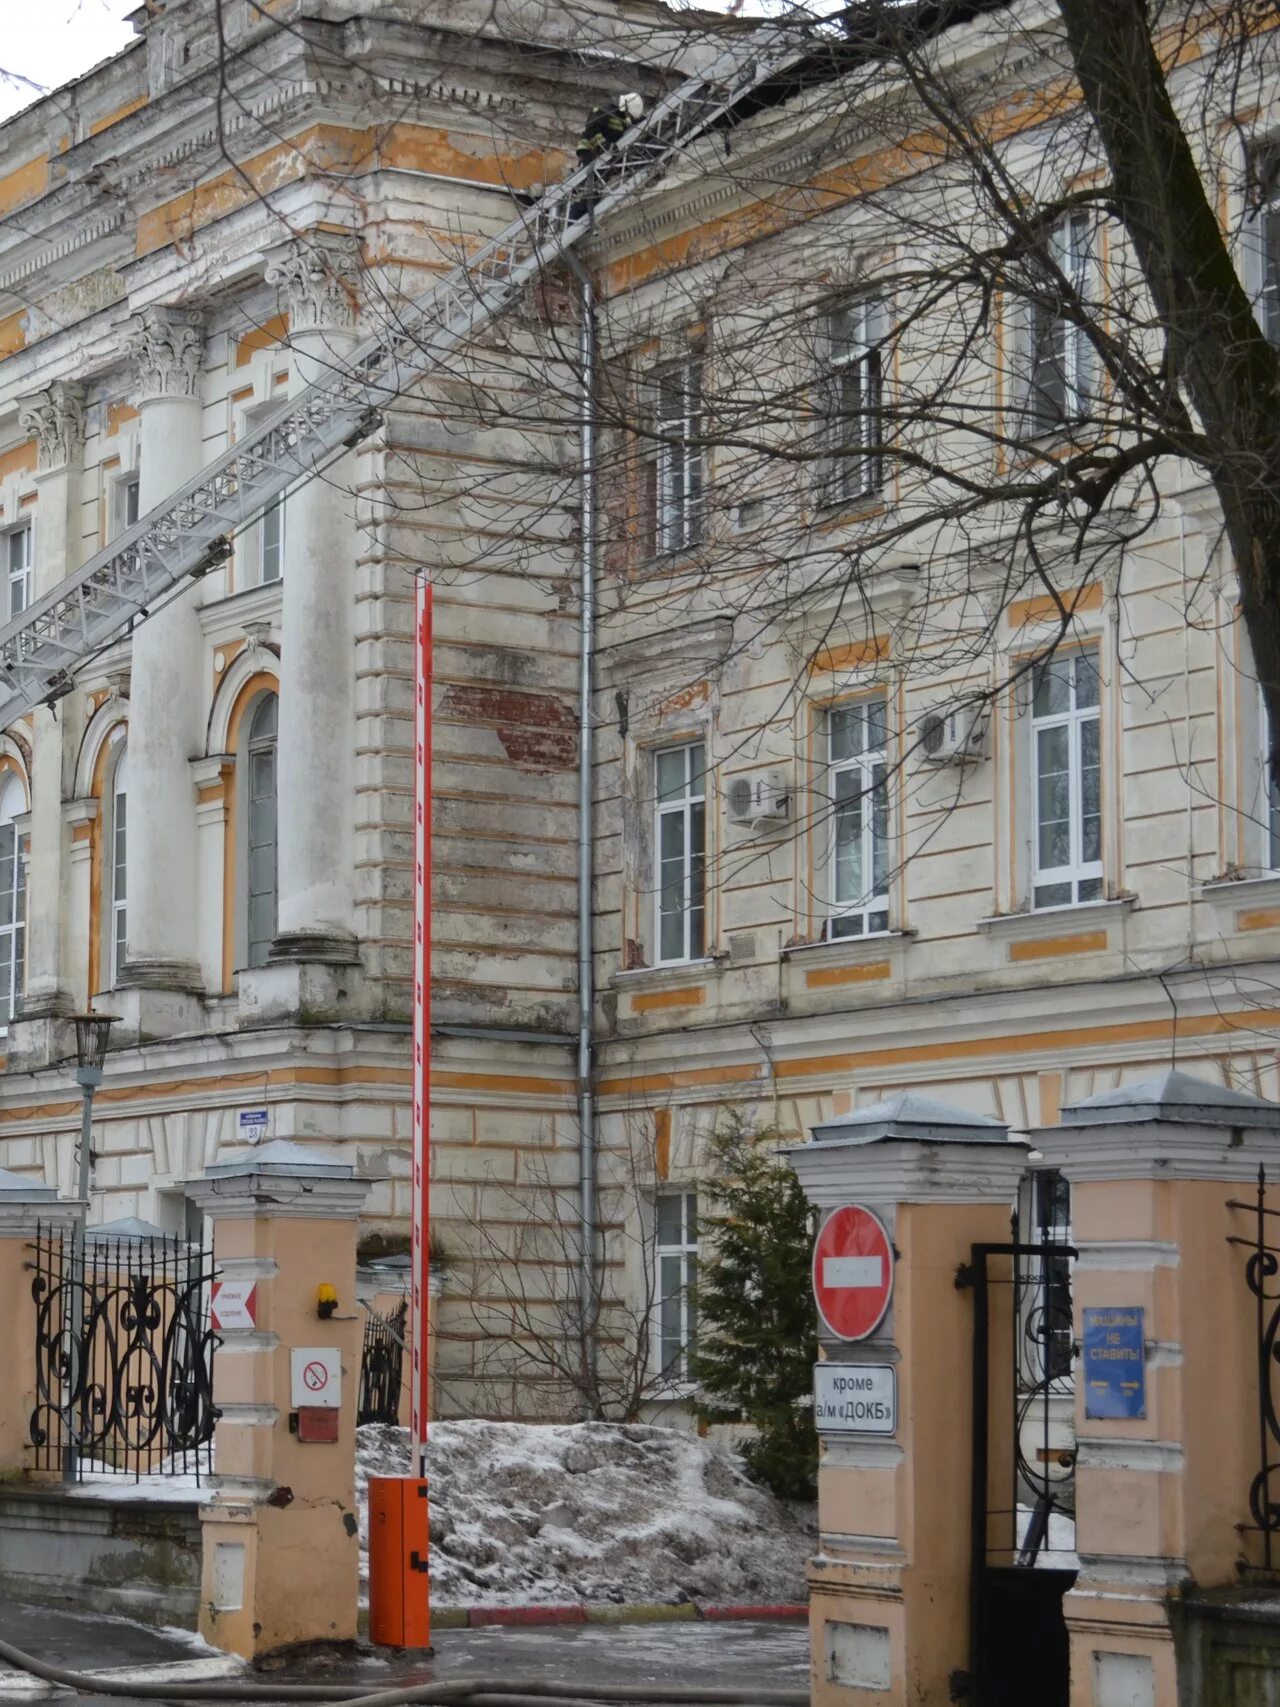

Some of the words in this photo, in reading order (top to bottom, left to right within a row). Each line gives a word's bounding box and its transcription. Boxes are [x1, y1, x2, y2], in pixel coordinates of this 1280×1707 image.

[1106, 1333, 1121, 1345] НЕ
[833, 1377, 874, 1394] кроме
[816, 1400, 836, 1418] а/м
